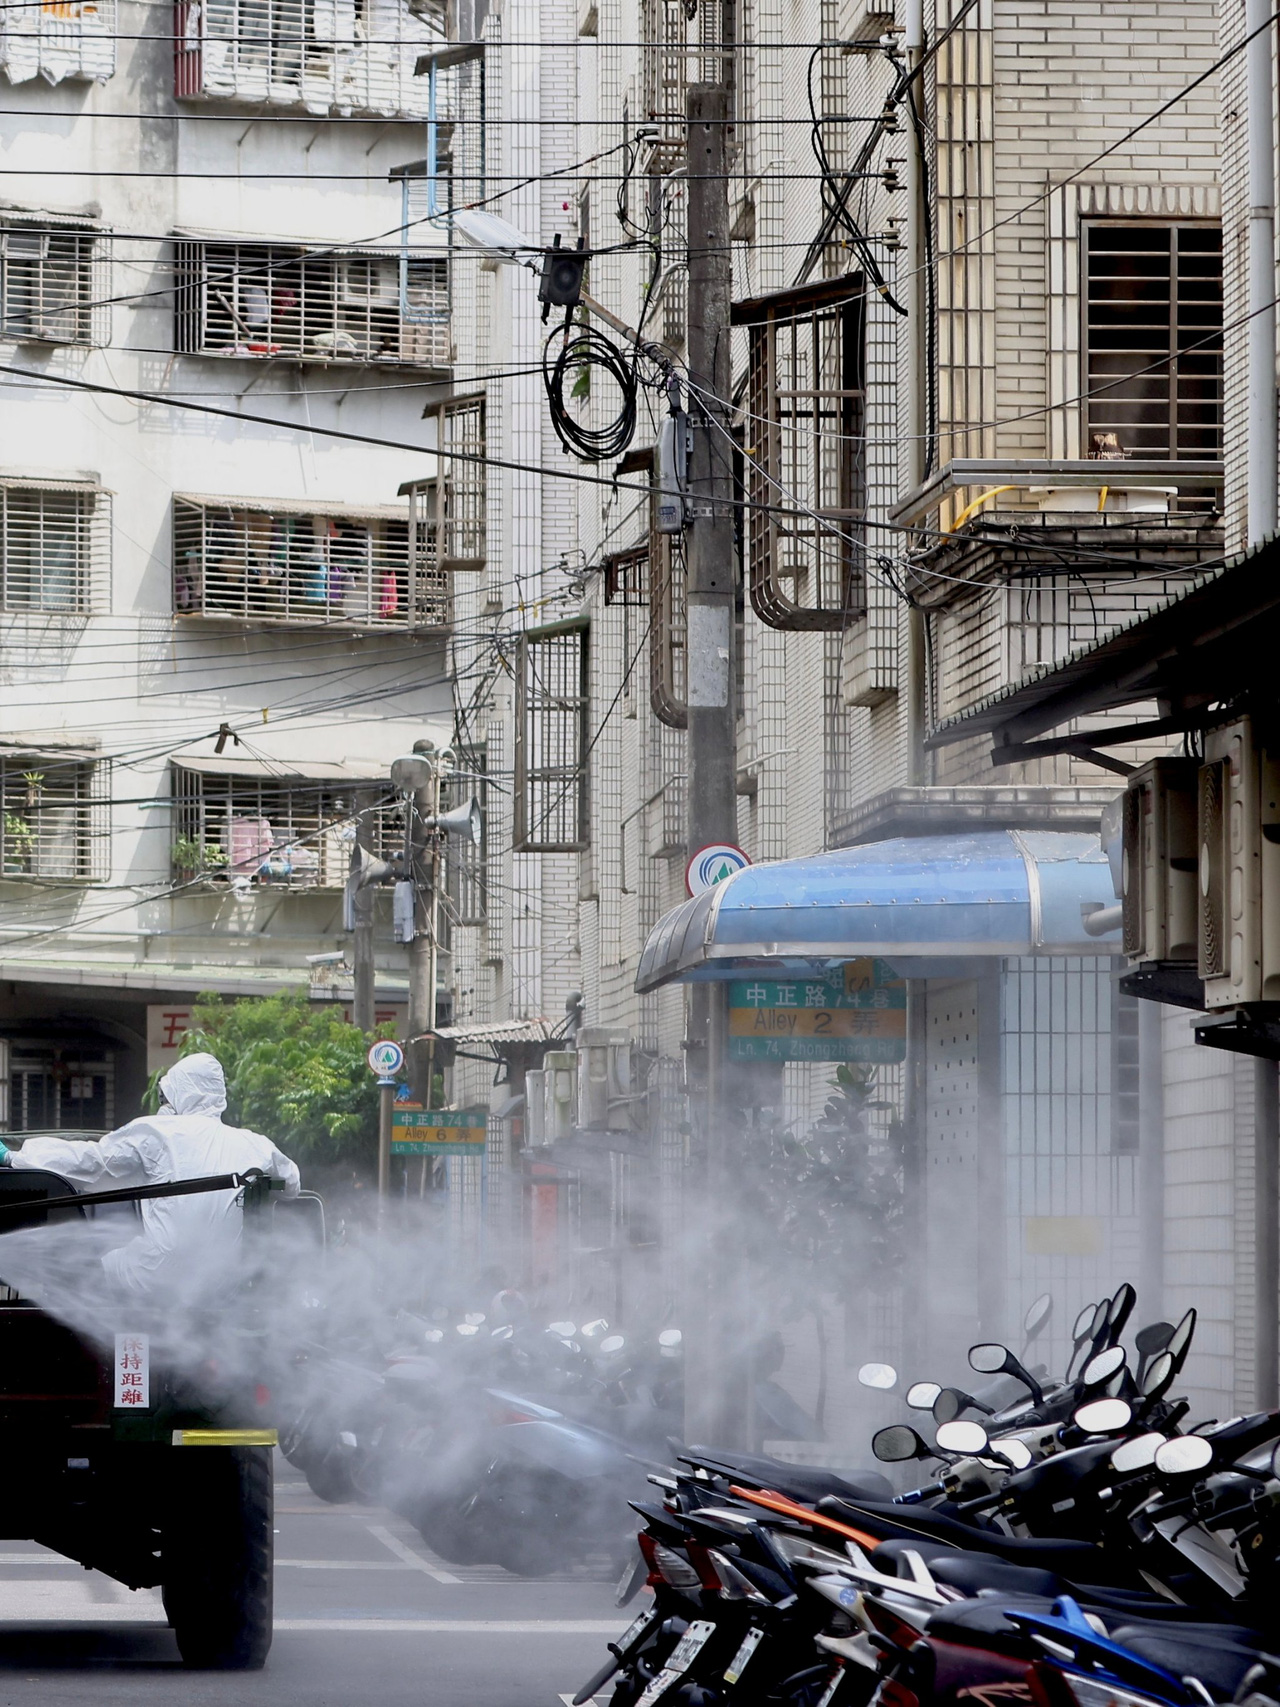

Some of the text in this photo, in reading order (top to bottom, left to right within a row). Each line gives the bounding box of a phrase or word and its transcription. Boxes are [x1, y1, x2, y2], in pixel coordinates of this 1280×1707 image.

[753, 1010, 880, 1035] Alley 2 弄
[738, 1040, 757, 1056] Ln.
[790, 1040, 870, 1060] Zhongzheng
[405, 1127, 428, 1144] Alley
[436, 1128, 447, 1141] 6
[120, 1338, 144, 1405] 保持距離
